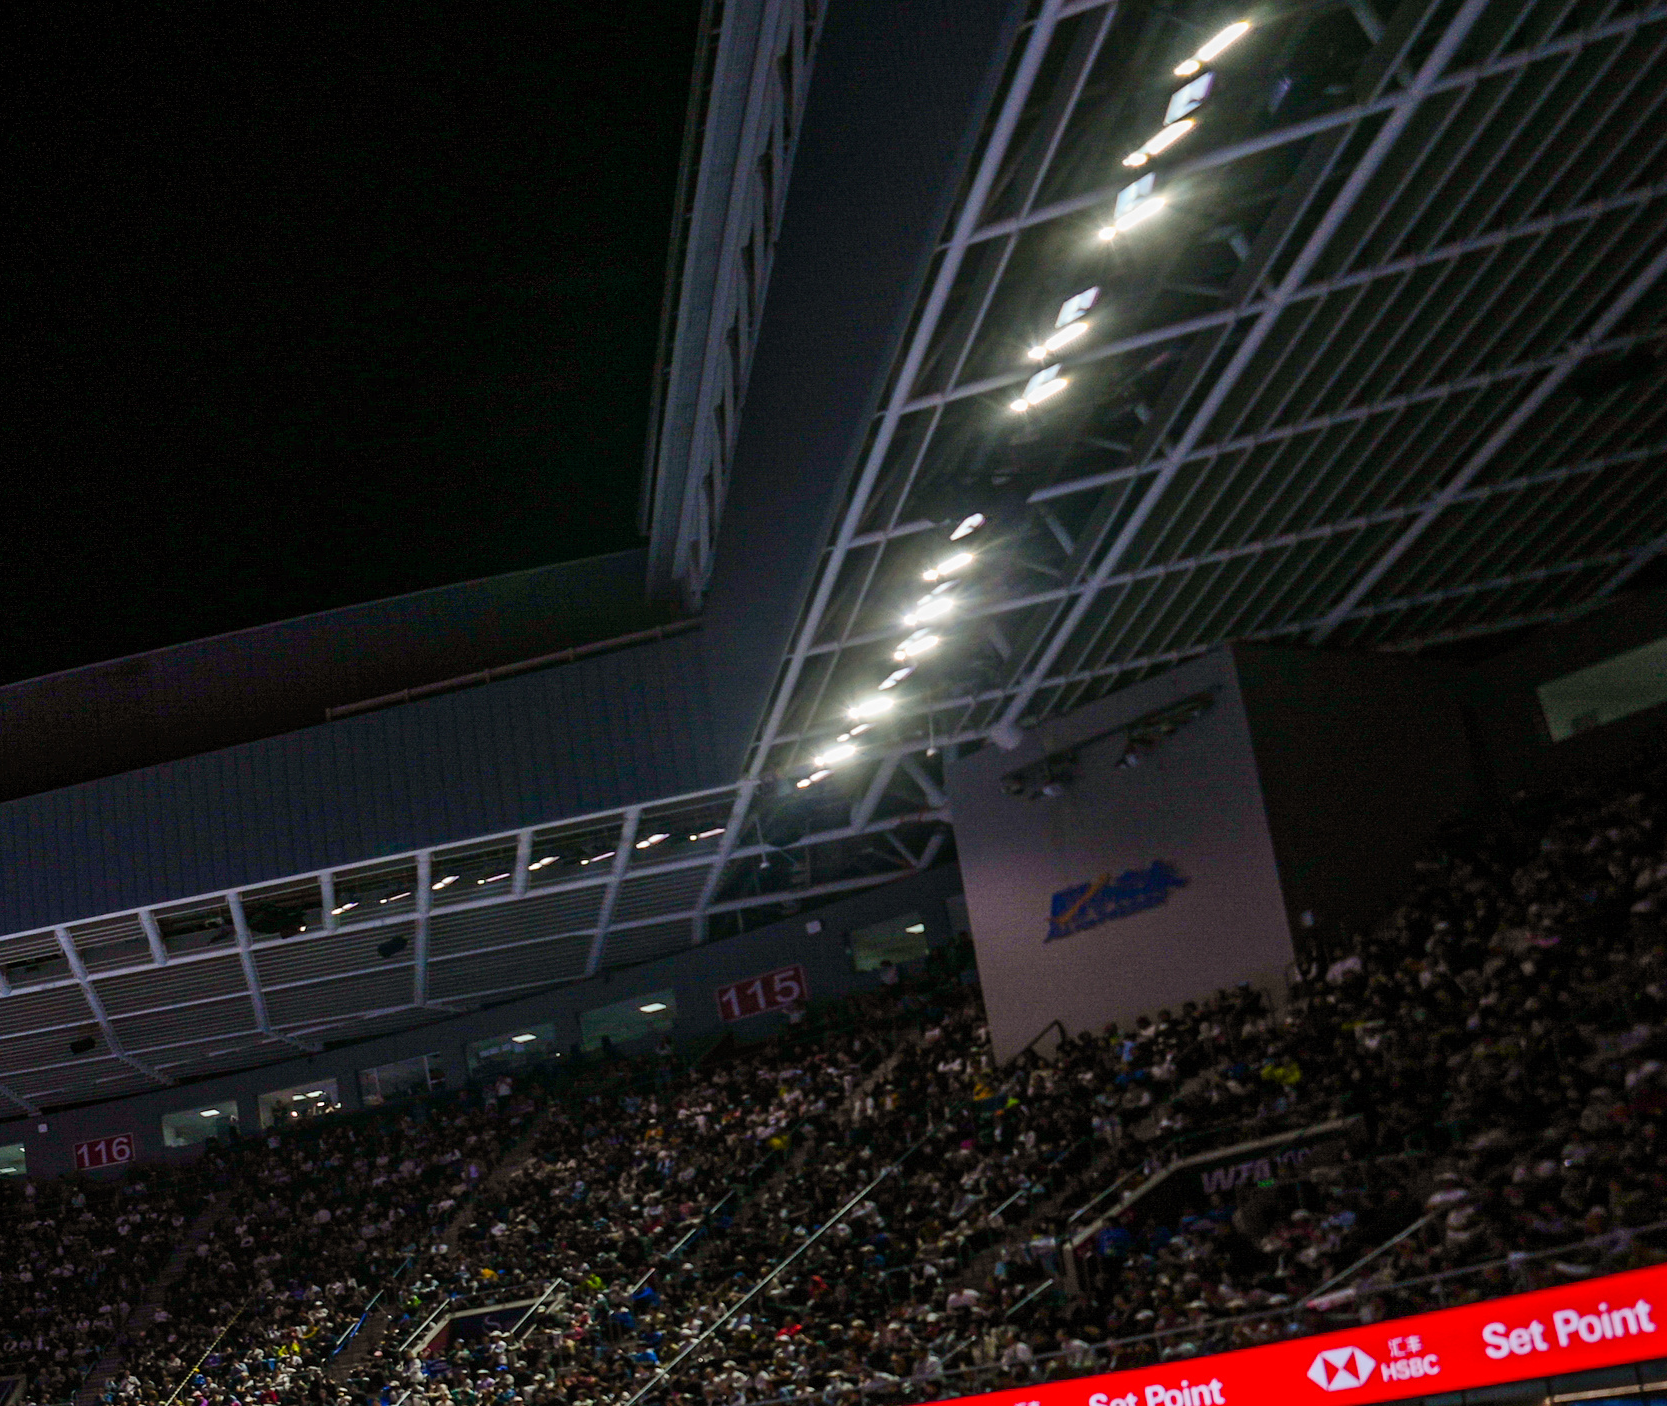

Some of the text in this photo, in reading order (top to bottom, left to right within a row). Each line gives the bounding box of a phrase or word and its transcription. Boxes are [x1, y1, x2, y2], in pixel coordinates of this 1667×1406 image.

[721, 970, 801, 1018] 115
[77, 1136, 131, 1167] 116
[1483, 1300, 1655, 1359] Set Point
